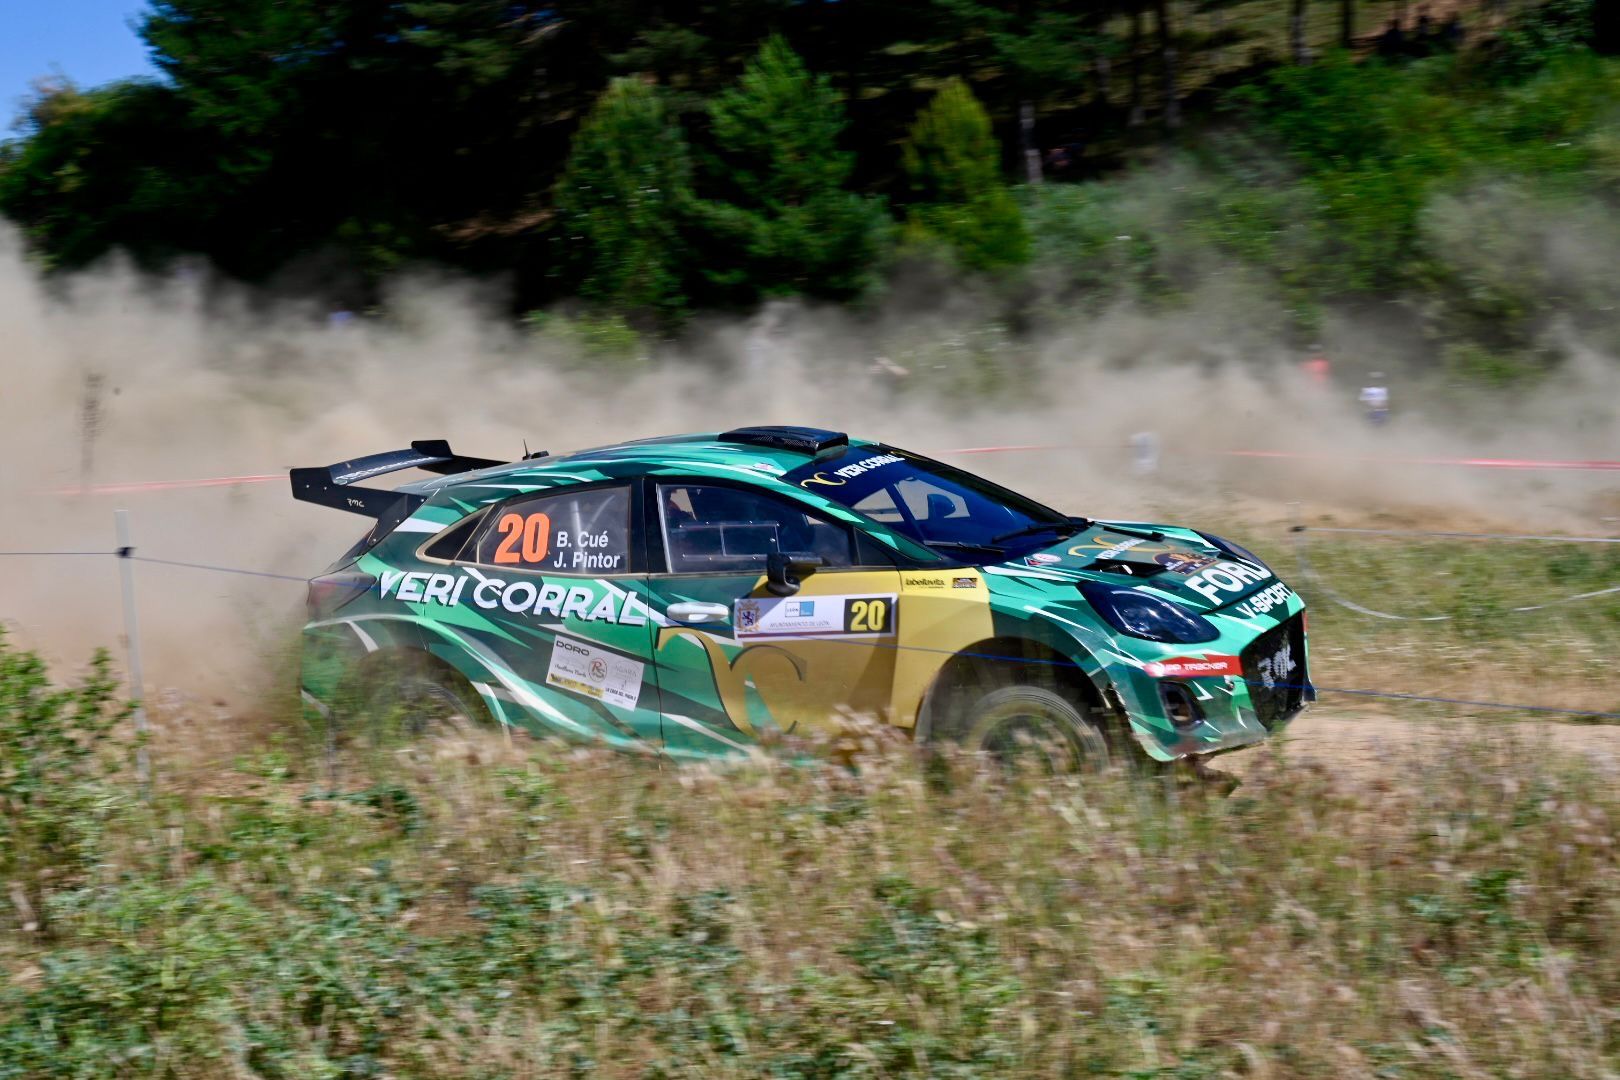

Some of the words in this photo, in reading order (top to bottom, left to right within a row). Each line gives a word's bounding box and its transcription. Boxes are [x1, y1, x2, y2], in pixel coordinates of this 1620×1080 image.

[833, 463, 868, 479] VERI
[494, 512, 550, 563] 20
[556, 531, 571, 548] B.
[577, 530, 609, 548] Cué
[553, 551, 567, 568] J.
[572, 551, 620, 568] Pintor
[1184, 557, 1272, 606] FORD
[379, 570, 469, 607] VERI
[473, 578, 649, 626] CORRAL
[850, 600, 886, 631] 20
[556, 640, 590, 656] DORO
